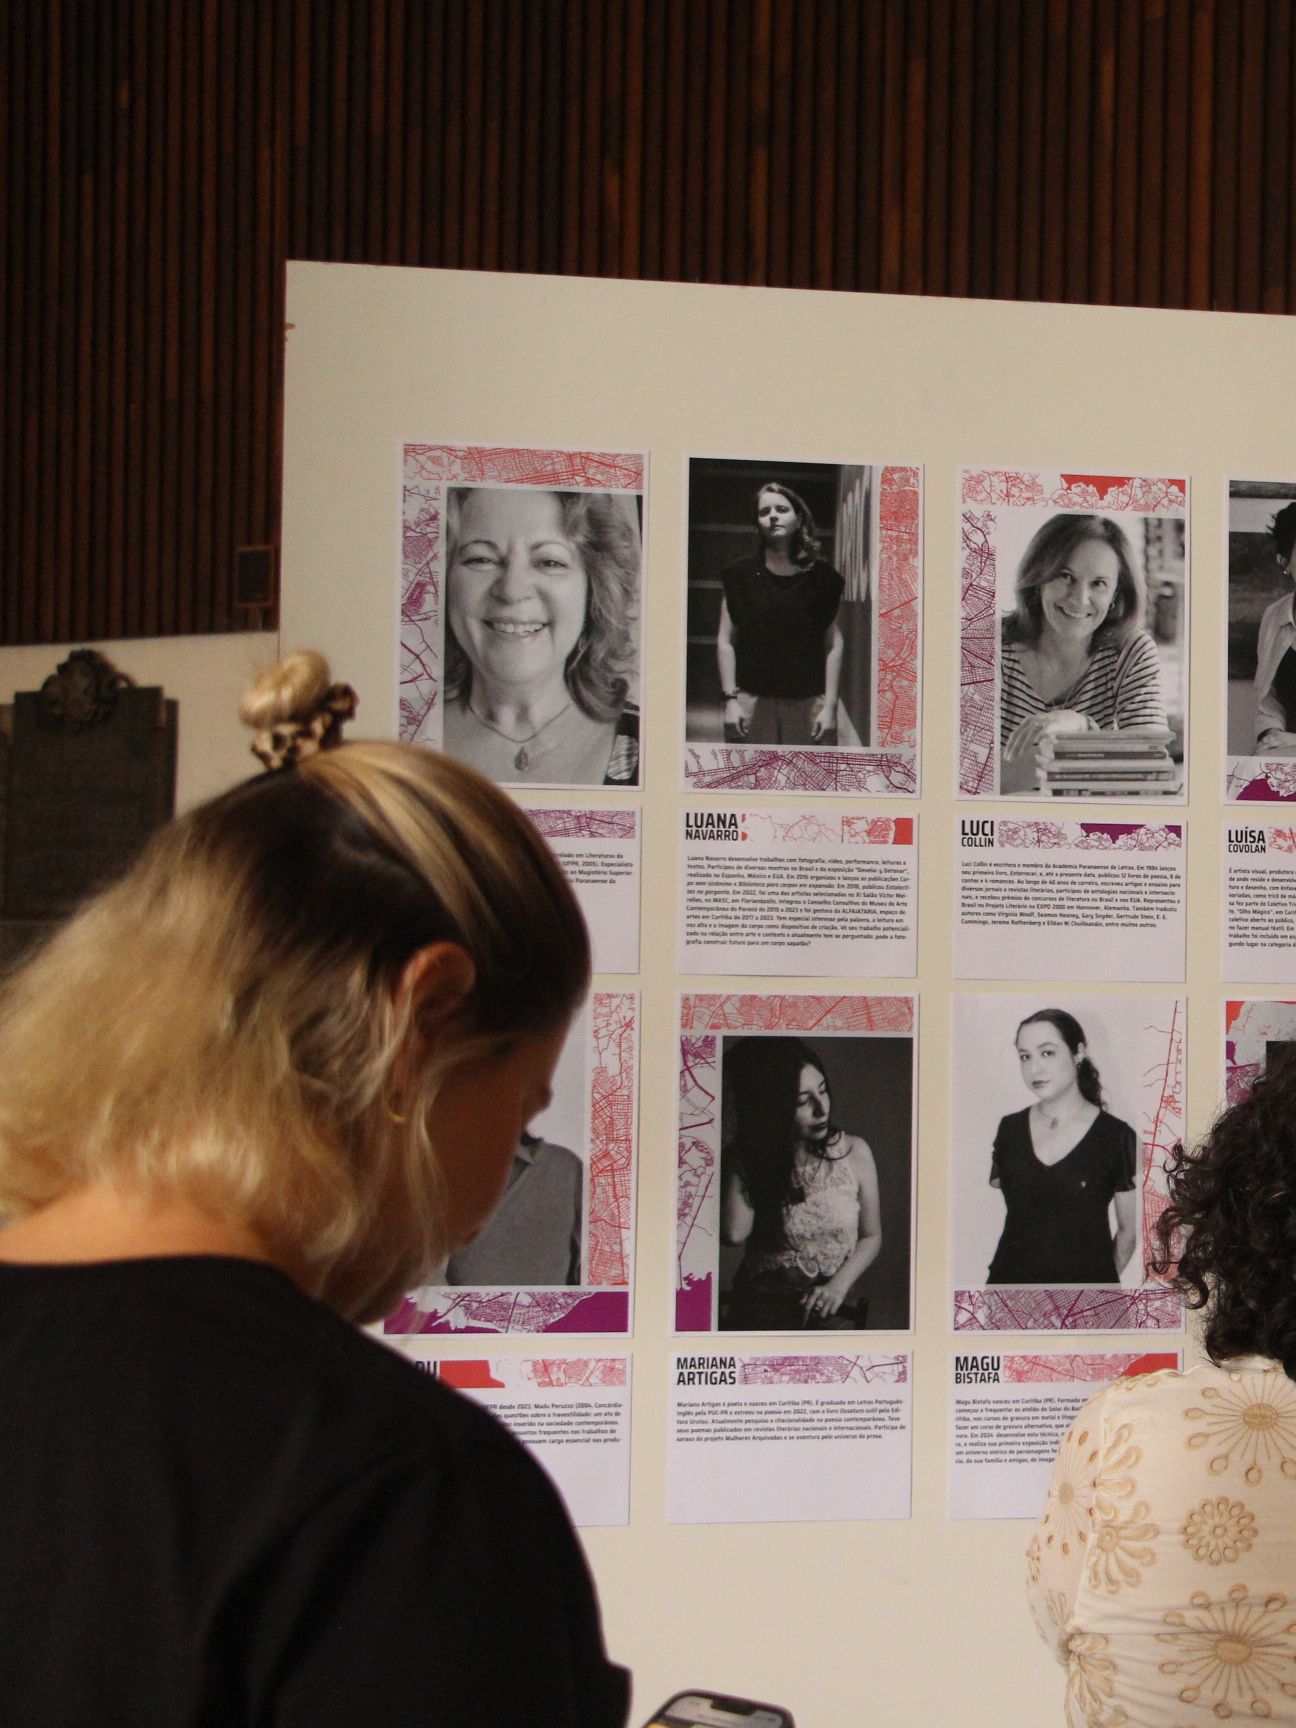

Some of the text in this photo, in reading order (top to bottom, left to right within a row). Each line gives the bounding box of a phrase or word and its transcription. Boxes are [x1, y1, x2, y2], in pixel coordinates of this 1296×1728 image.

[686, 812, 738, 829] LUANA
[961, 820, 994, 836] LUCI
[685, 829, 738, 841] NAVARRO
[1228, 827, 1266, 844] LUÍSA
[961, 837, 994, 848] COLLIN
[1228, 844, 1266, 853] COVOLAN
[677, 1357, 735, 1369] MARIANA
[955, 1356, 1000, 1371] MAGU
[677, 1371, 736, 1385] ARTIGAS
[955, 1372, 1000, 1383] BISTAFA
